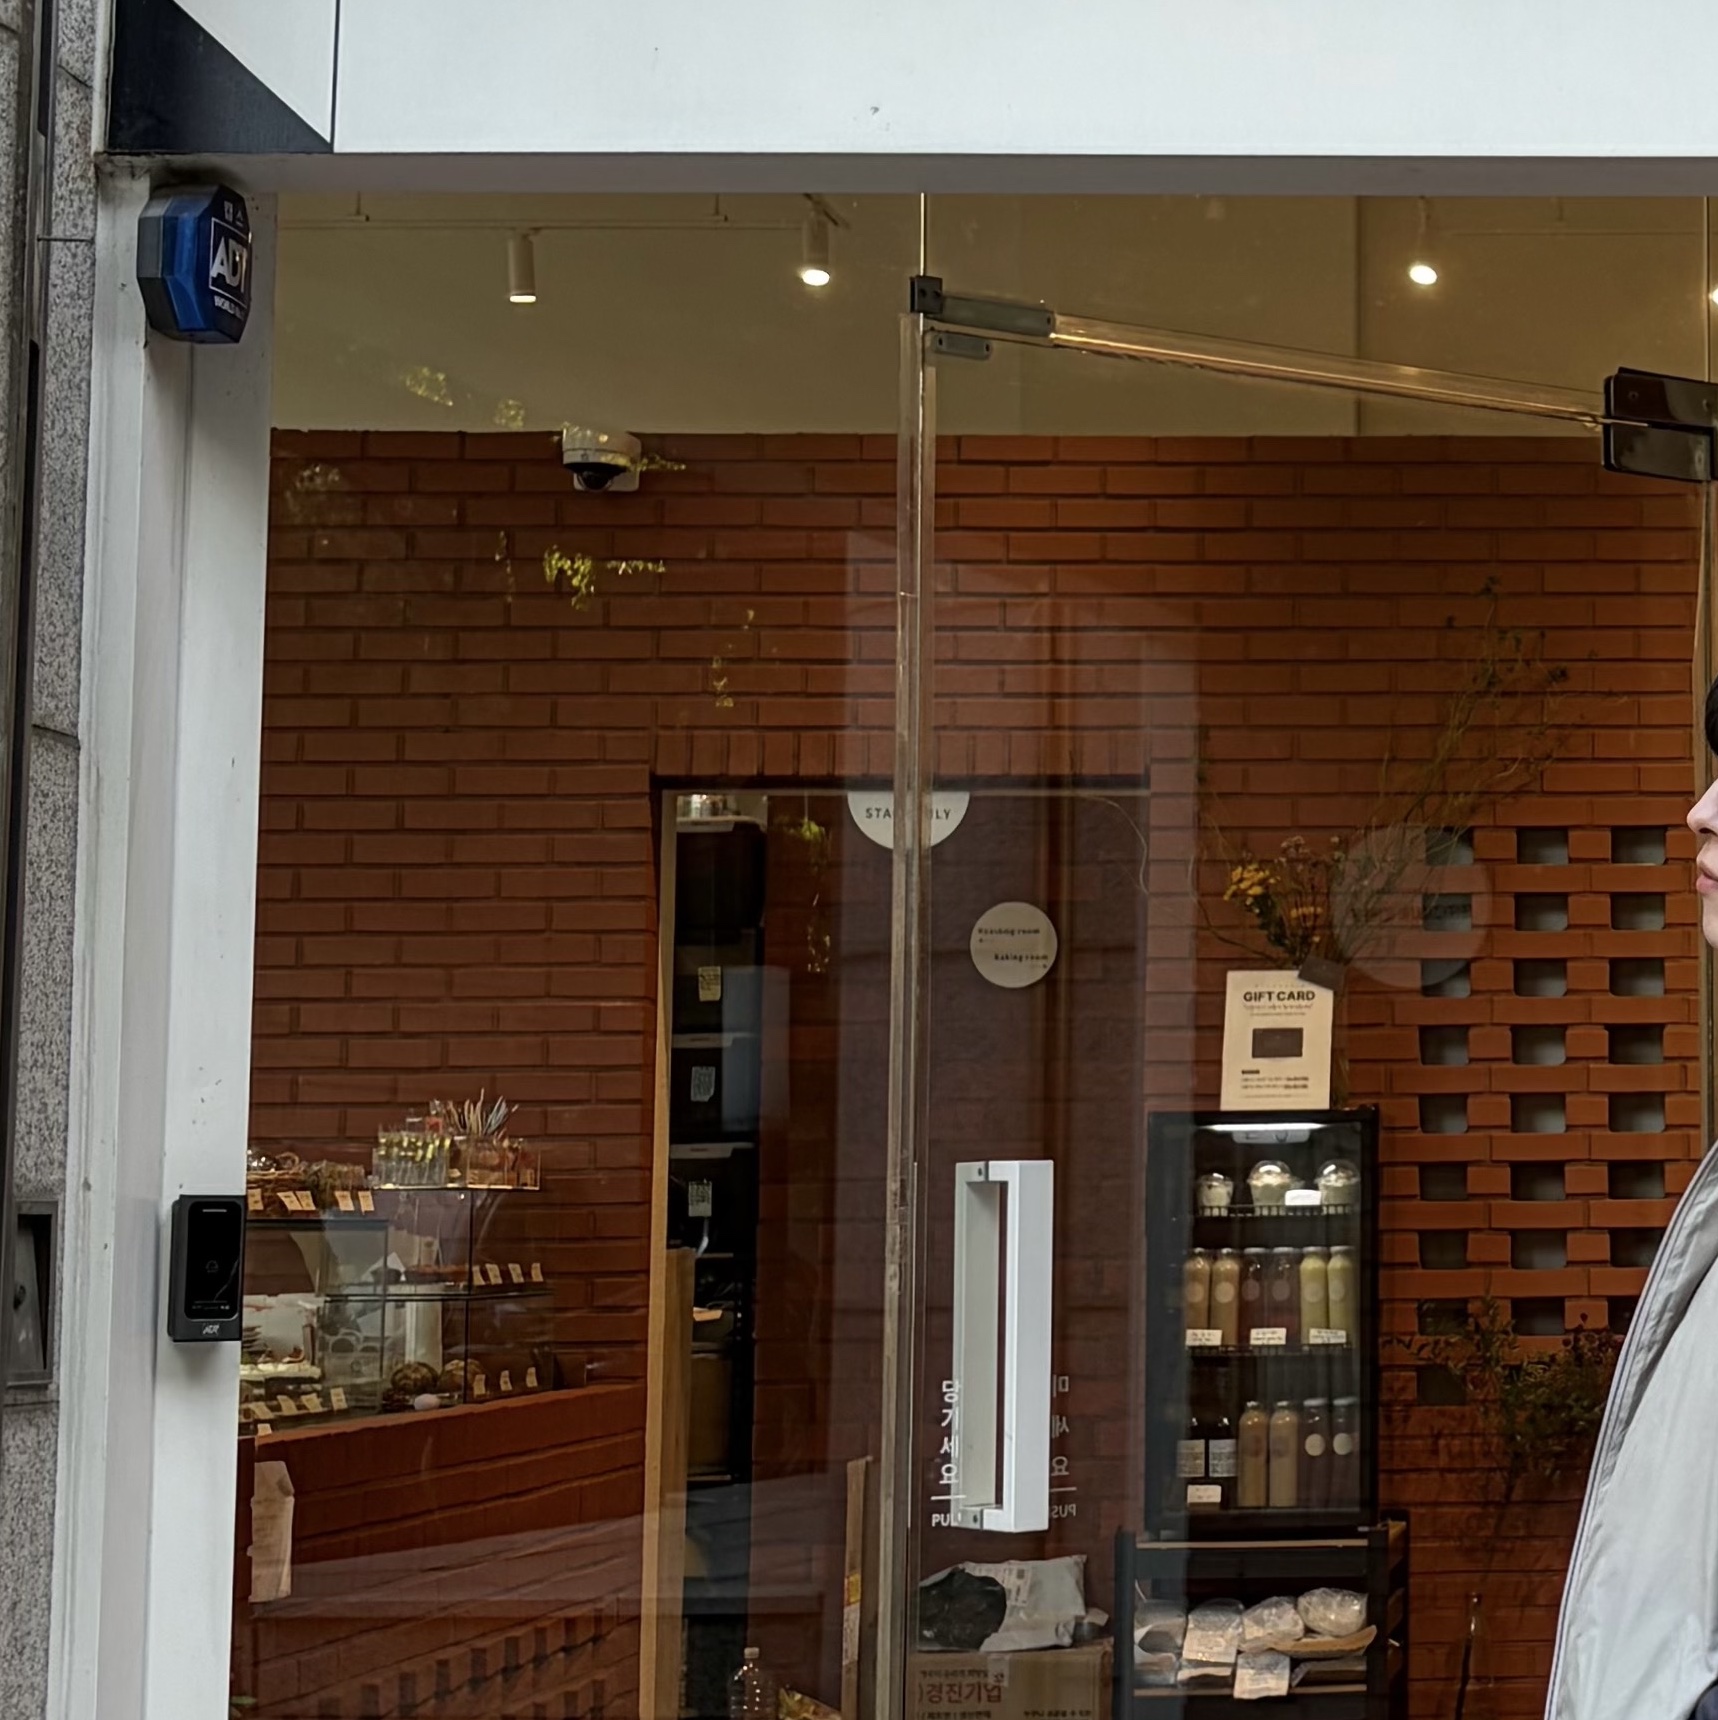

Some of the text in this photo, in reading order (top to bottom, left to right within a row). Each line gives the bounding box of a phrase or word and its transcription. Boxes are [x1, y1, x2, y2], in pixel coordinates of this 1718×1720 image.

[211, 236, 248, 294] ADT
[865, 807, 892, 819] STA
[1243, 990, 1316, 1003] GIFT CARD
